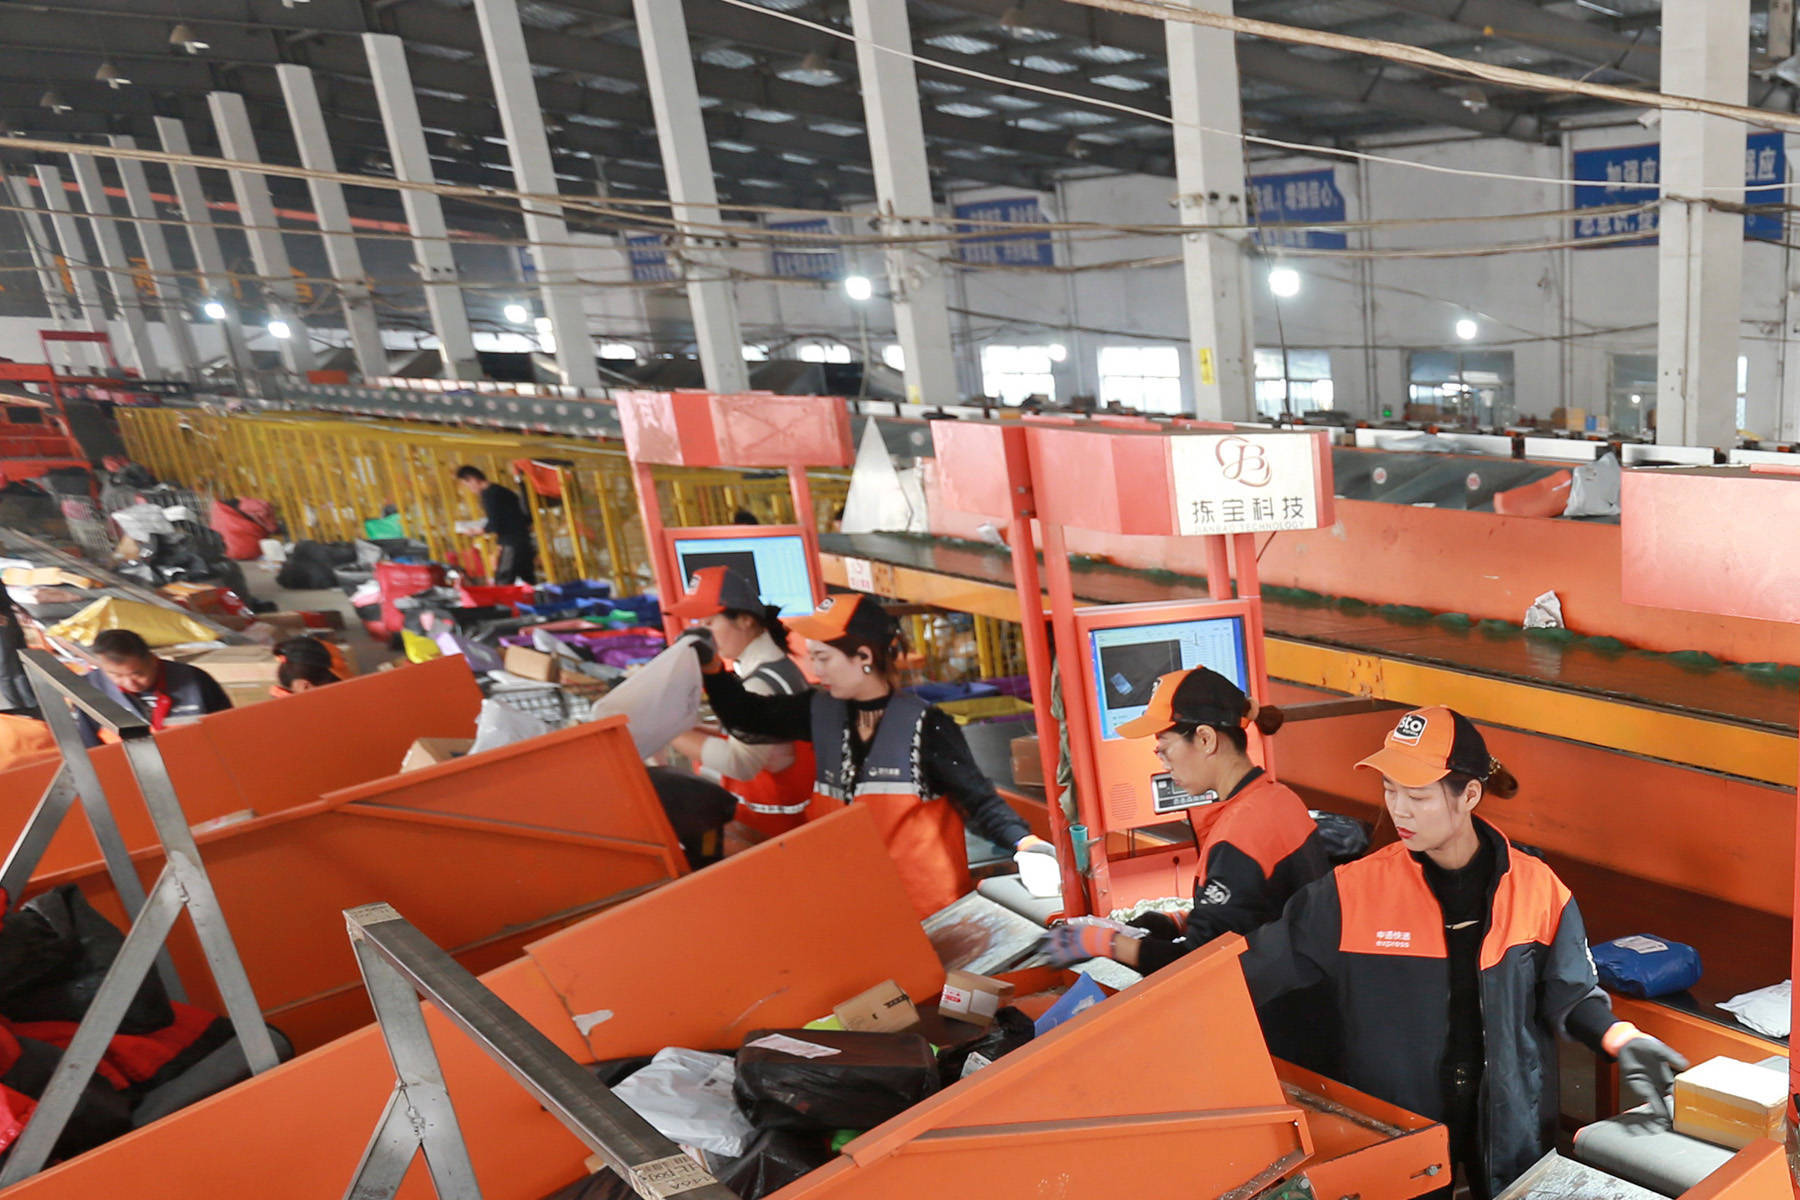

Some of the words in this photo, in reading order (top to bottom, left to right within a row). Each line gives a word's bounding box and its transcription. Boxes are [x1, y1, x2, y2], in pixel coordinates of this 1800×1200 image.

[1192, 496, 1305, 525] 拣宝科技
[1400, 714, 1423, 732] sto
[1376, 939, 1410, 949] express
